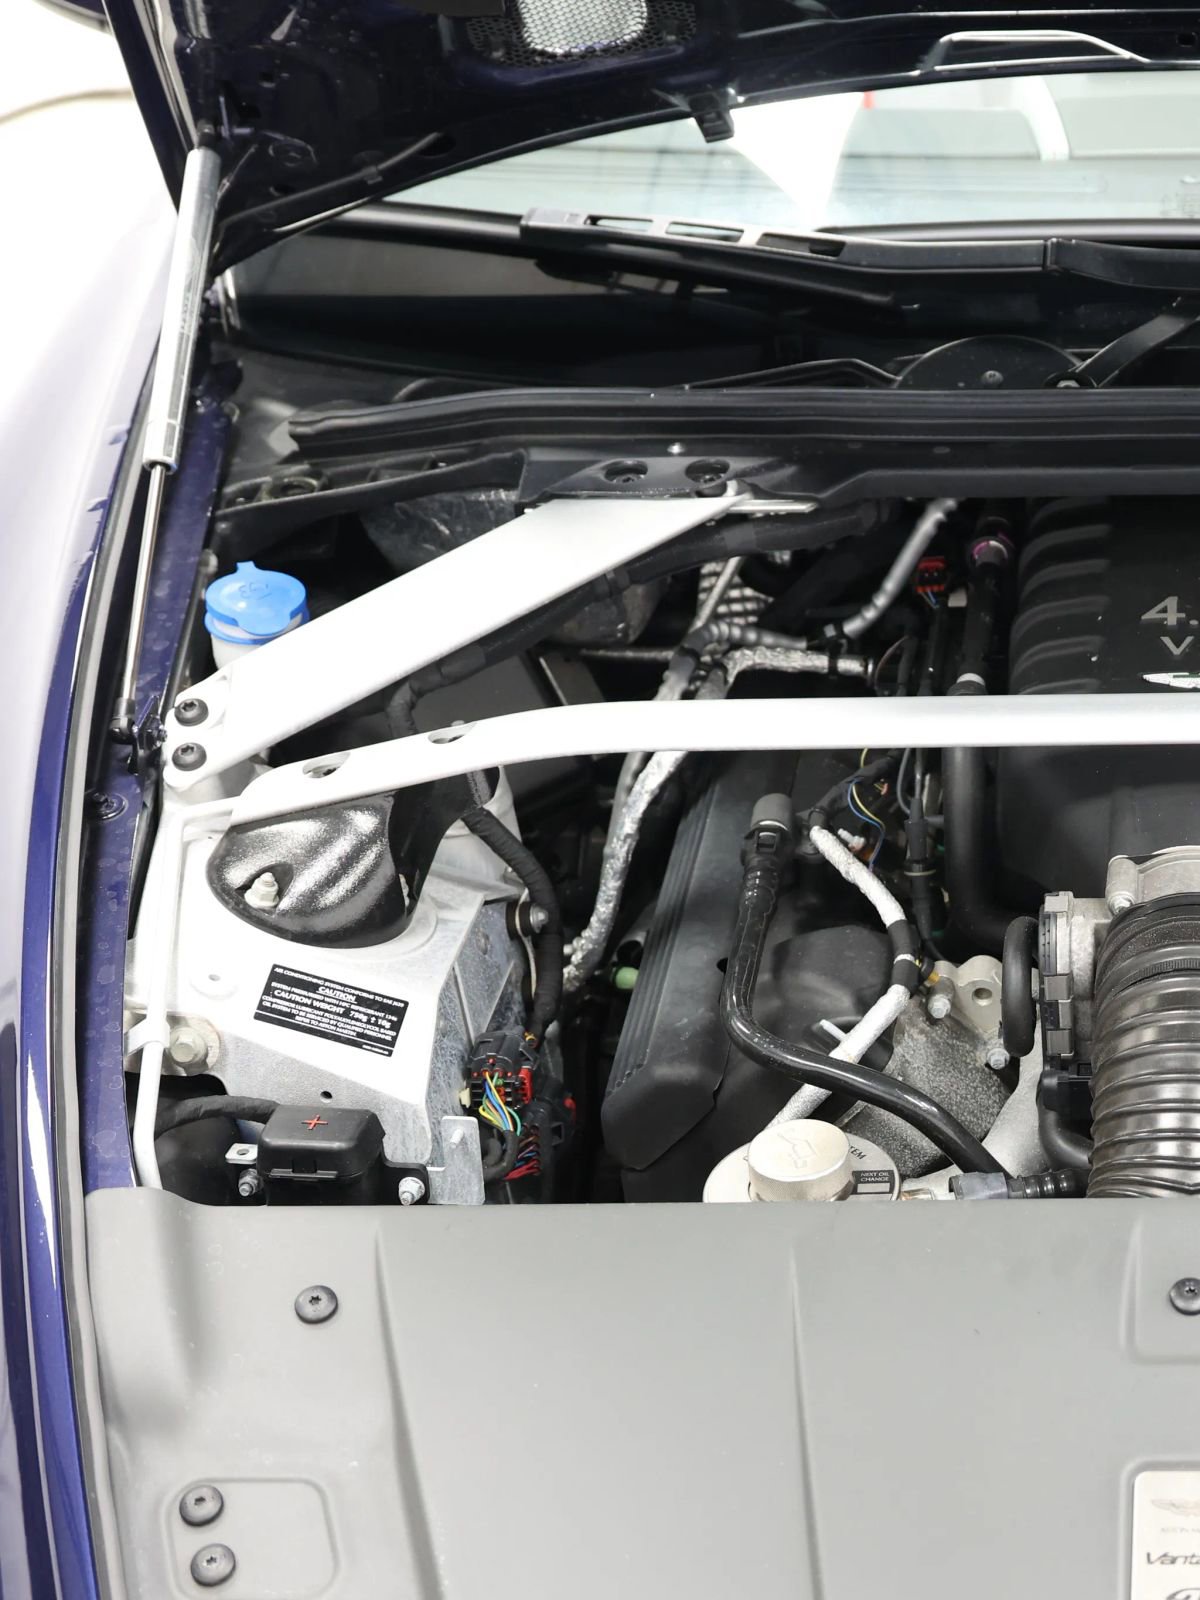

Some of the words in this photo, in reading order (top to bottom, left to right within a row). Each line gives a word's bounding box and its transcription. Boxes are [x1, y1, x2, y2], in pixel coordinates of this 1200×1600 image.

[274, 990, 312, 1004] CAUTION
[313, 1000, 345, 1013] WEIGHT
[318, 987, 356, 1001] CAUTION
